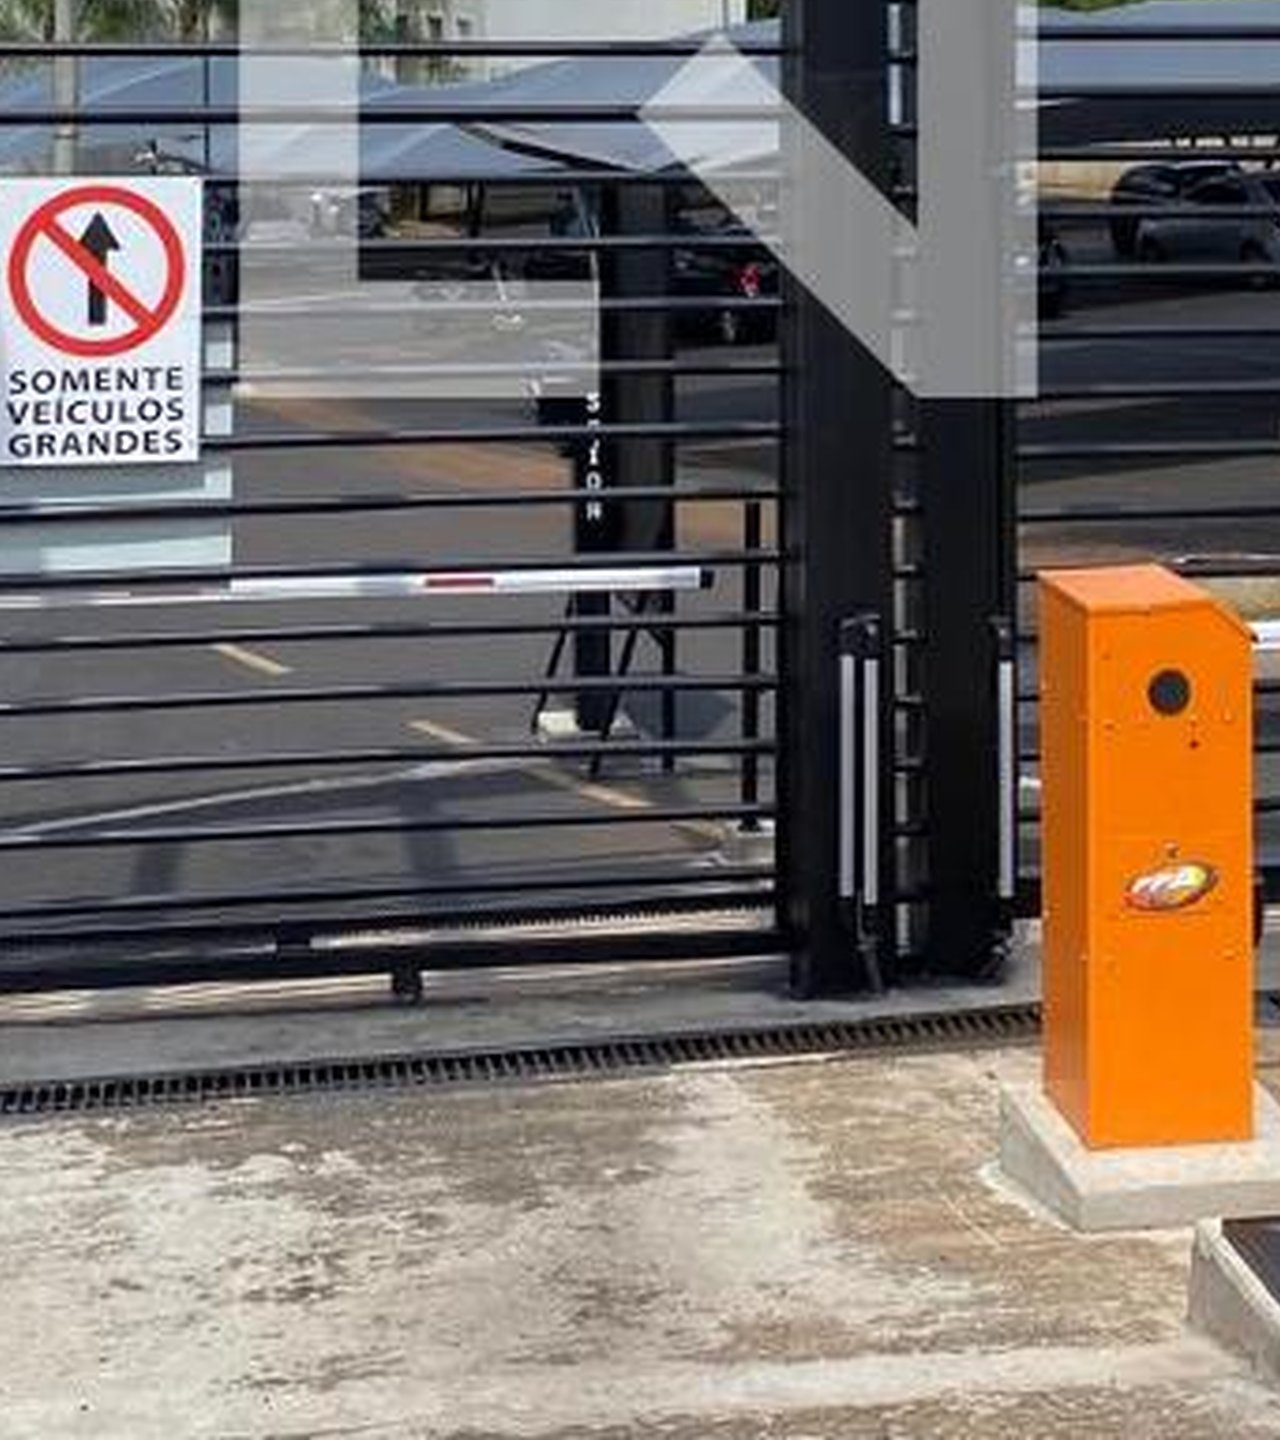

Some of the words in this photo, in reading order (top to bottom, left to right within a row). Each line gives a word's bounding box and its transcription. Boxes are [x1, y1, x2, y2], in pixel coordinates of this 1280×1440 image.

[9, 367, 183, 394] SOMENTE
[7, 394, 183, 426] VEÍCULOS
[8, 430, 182, 458] GRANDES
